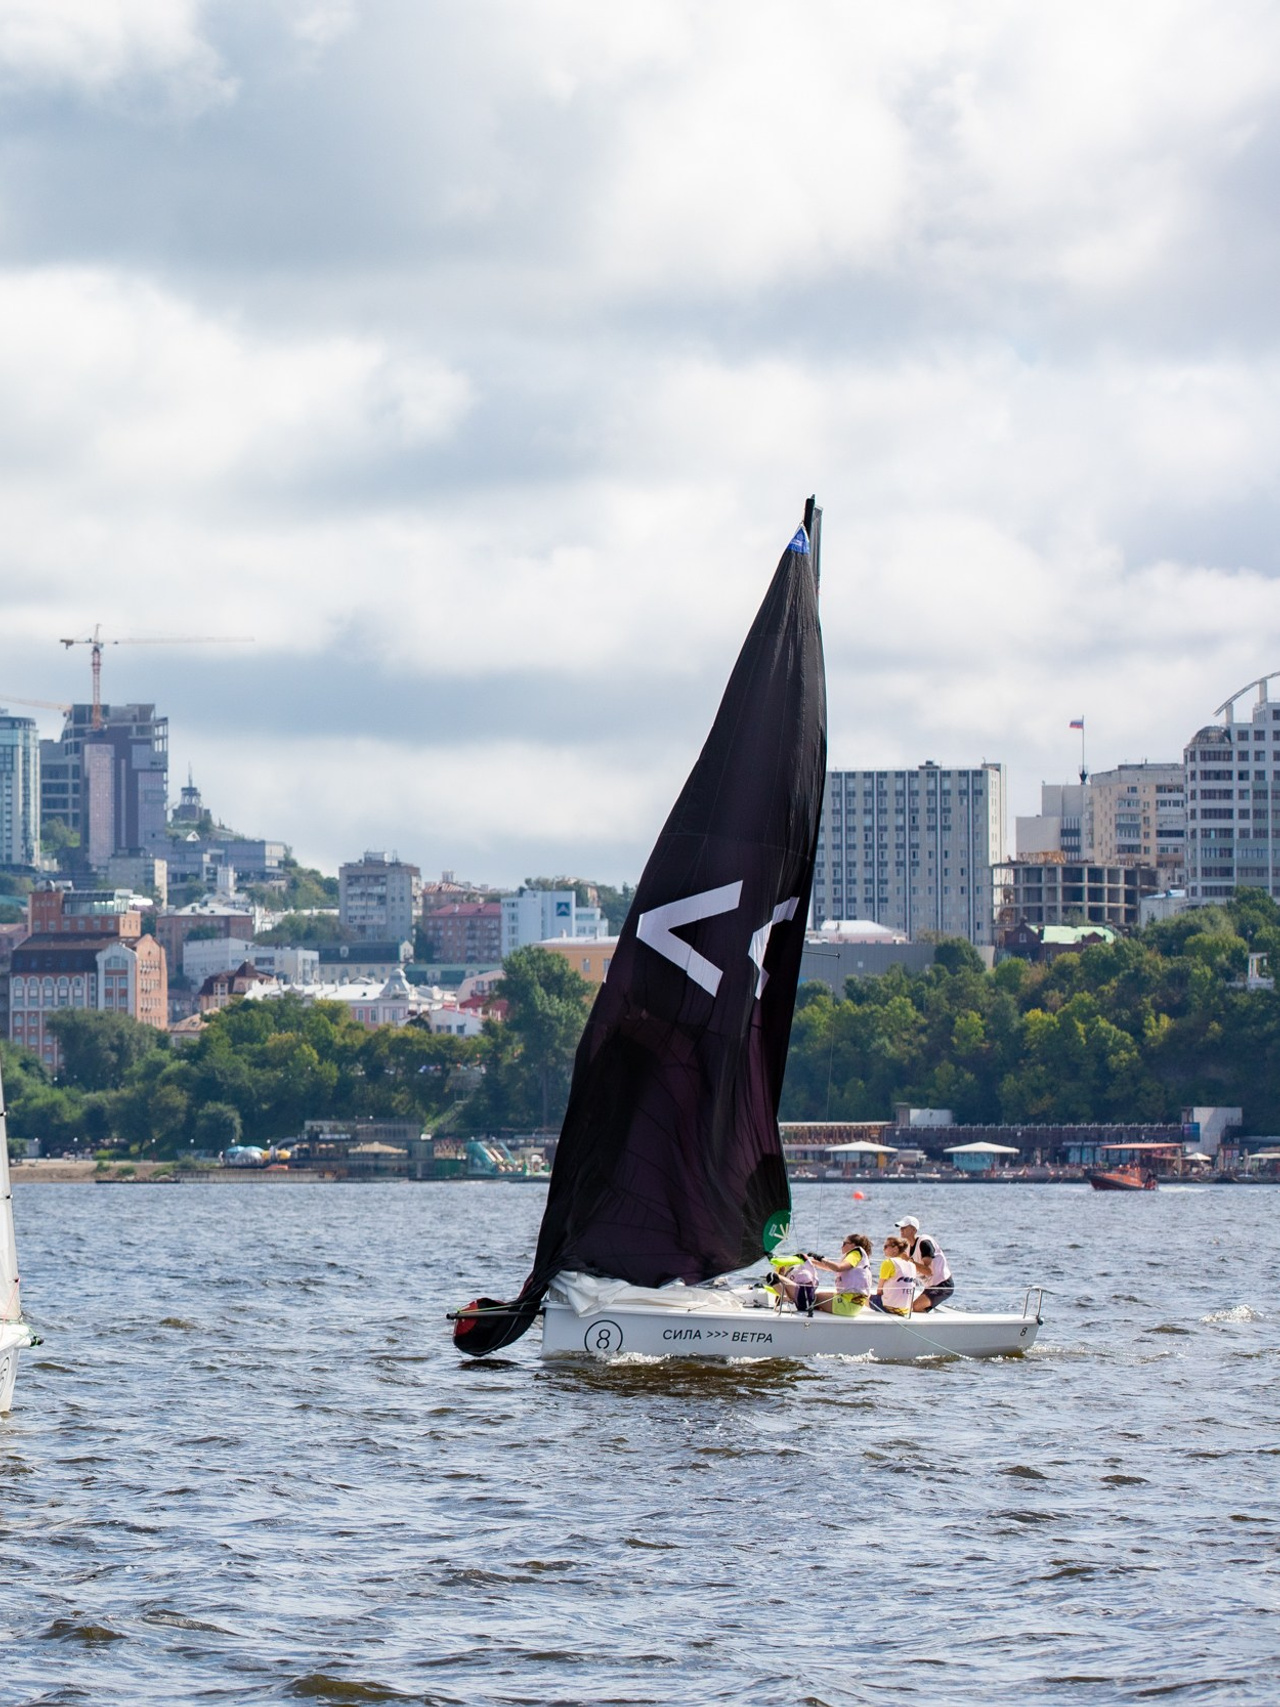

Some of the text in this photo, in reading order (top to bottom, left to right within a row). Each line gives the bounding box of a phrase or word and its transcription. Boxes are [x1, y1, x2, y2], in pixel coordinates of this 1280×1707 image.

[662, 1329, 773, 1344] СИЛА ВЕТРА
[1020, 1326, 1028, 1336] 8
[596, 1329, 611, 1349] 8
